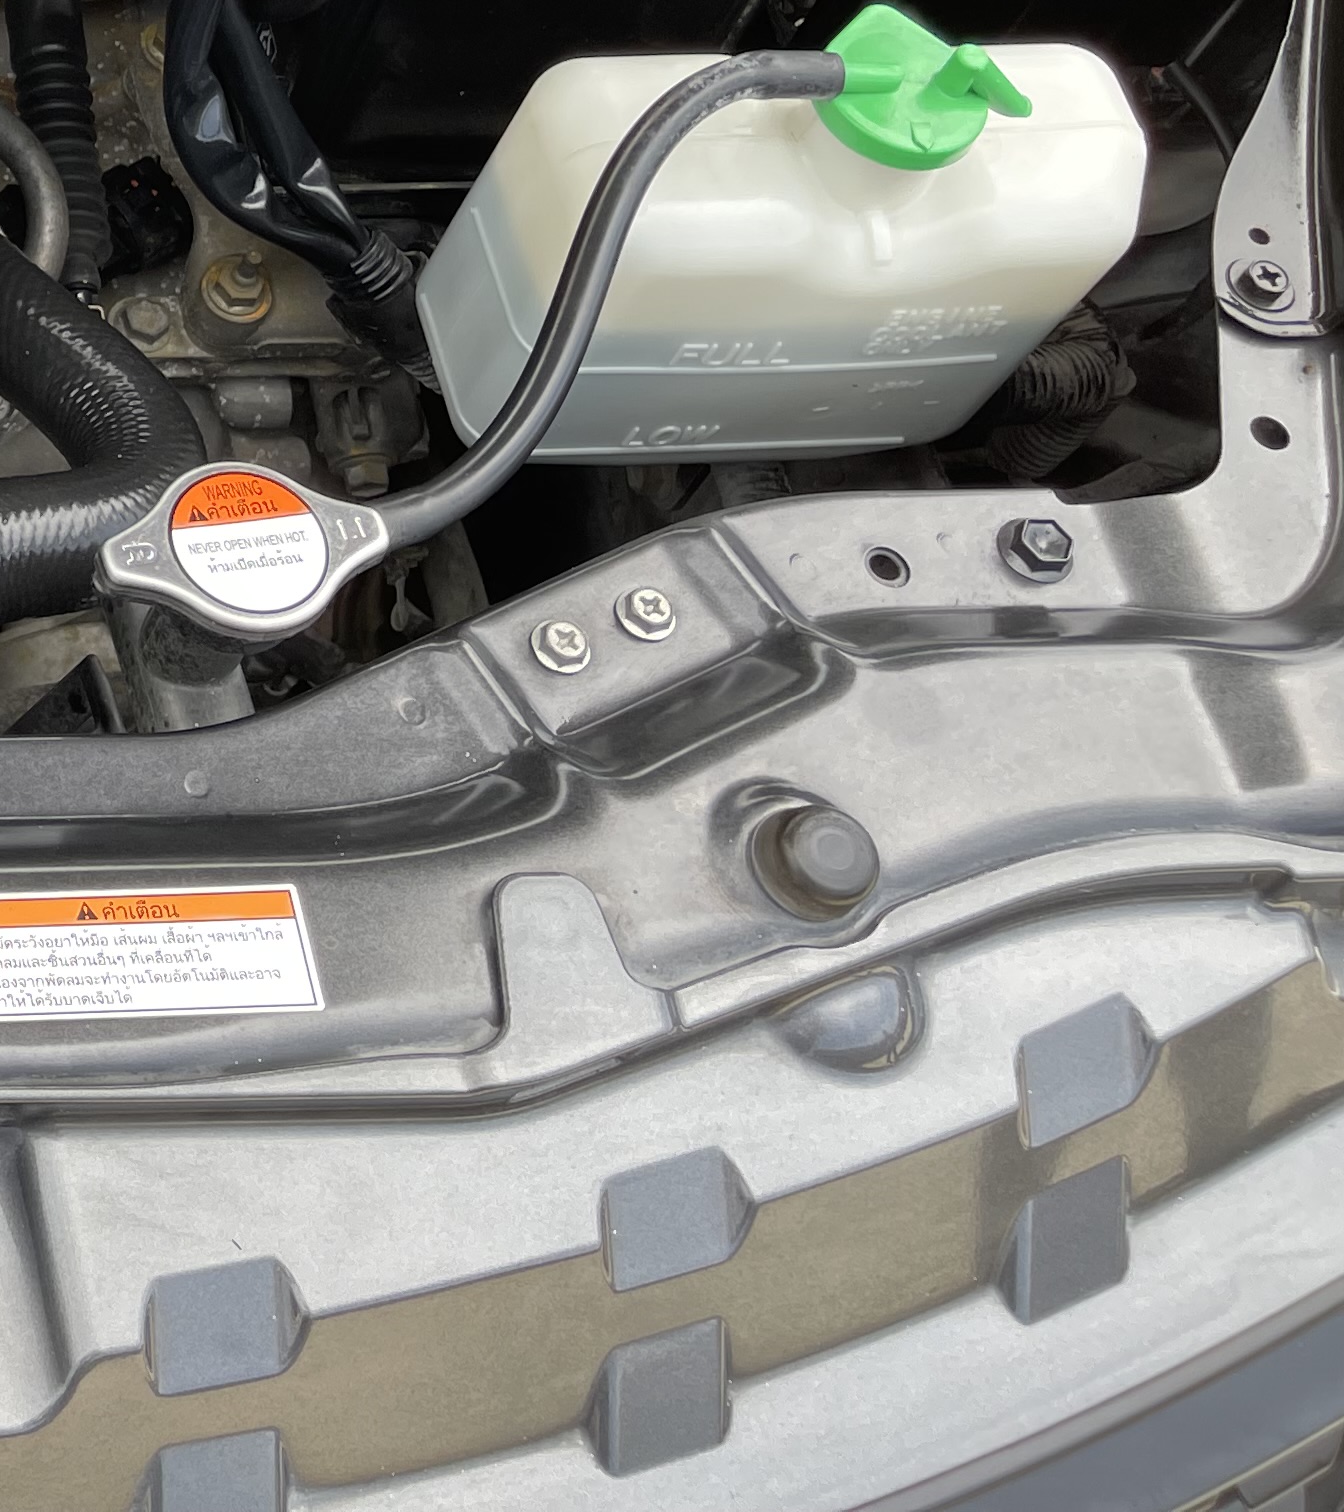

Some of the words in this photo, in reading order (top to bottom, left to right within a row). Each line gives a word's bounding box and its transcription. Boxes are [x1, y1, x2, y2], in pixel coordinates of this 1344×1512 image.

[669, 341, 791, 366] FULL
[622, 424, 720, 447] LOW
[203, 479, 263, 501] WARNING
[207, 497, 279, 520] คำเตือน
[188, 539, 223, 556] NEVER
[223, 536, 252, 551] OPEN
[252, 533, 282, 549] WHEN
[102, 901, 180, 922] คำเตือน
